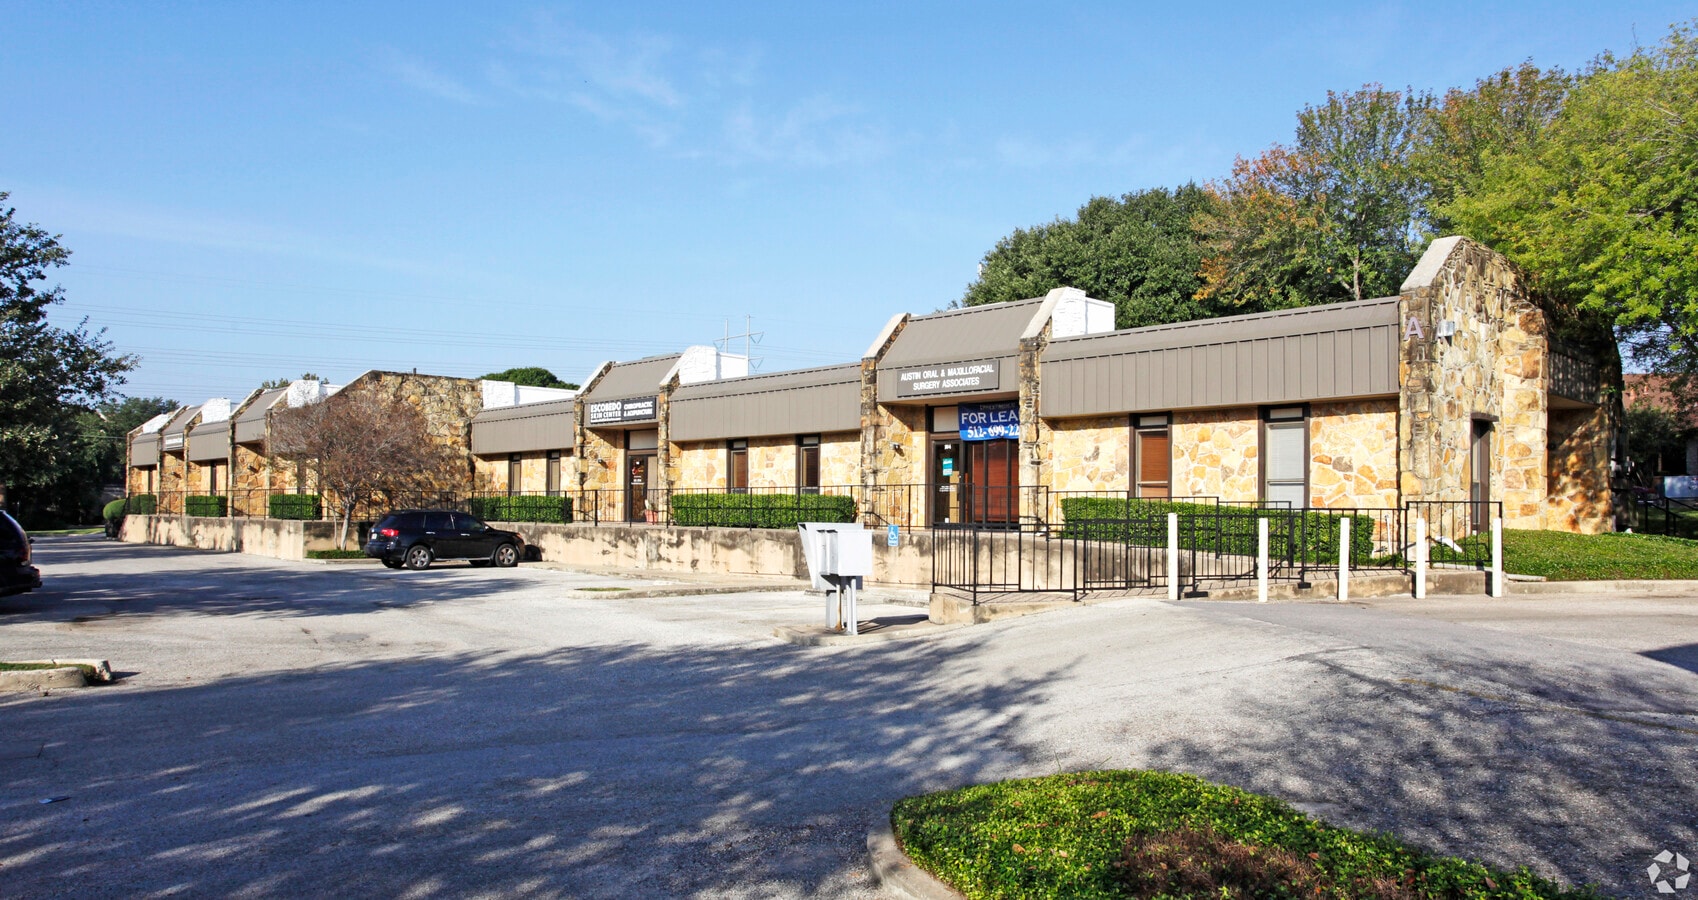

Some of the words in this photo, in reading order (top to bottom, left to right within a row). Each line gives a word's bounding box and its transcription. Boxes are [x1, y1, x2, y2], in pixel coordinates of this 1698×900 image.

[1403, 316, 1424, 341] A
[901, 371, 921, 381] AUSTIN
[923, 369, 939, 379] ORAL
[940, 369, 945, 377] &
[947, 364, 994, 376] MAXILLOFACIAL
[913, 380, 940, 390] SURGERY
[942, 376, 980, 388] ASSOCIATES
[591, 402, 621, 412] ESCOBEDO
[961, 412, 987, 424] FOR
[990, 409, 1018, 423] LEA
[967, 424, 1020, 437] 512-699-22
